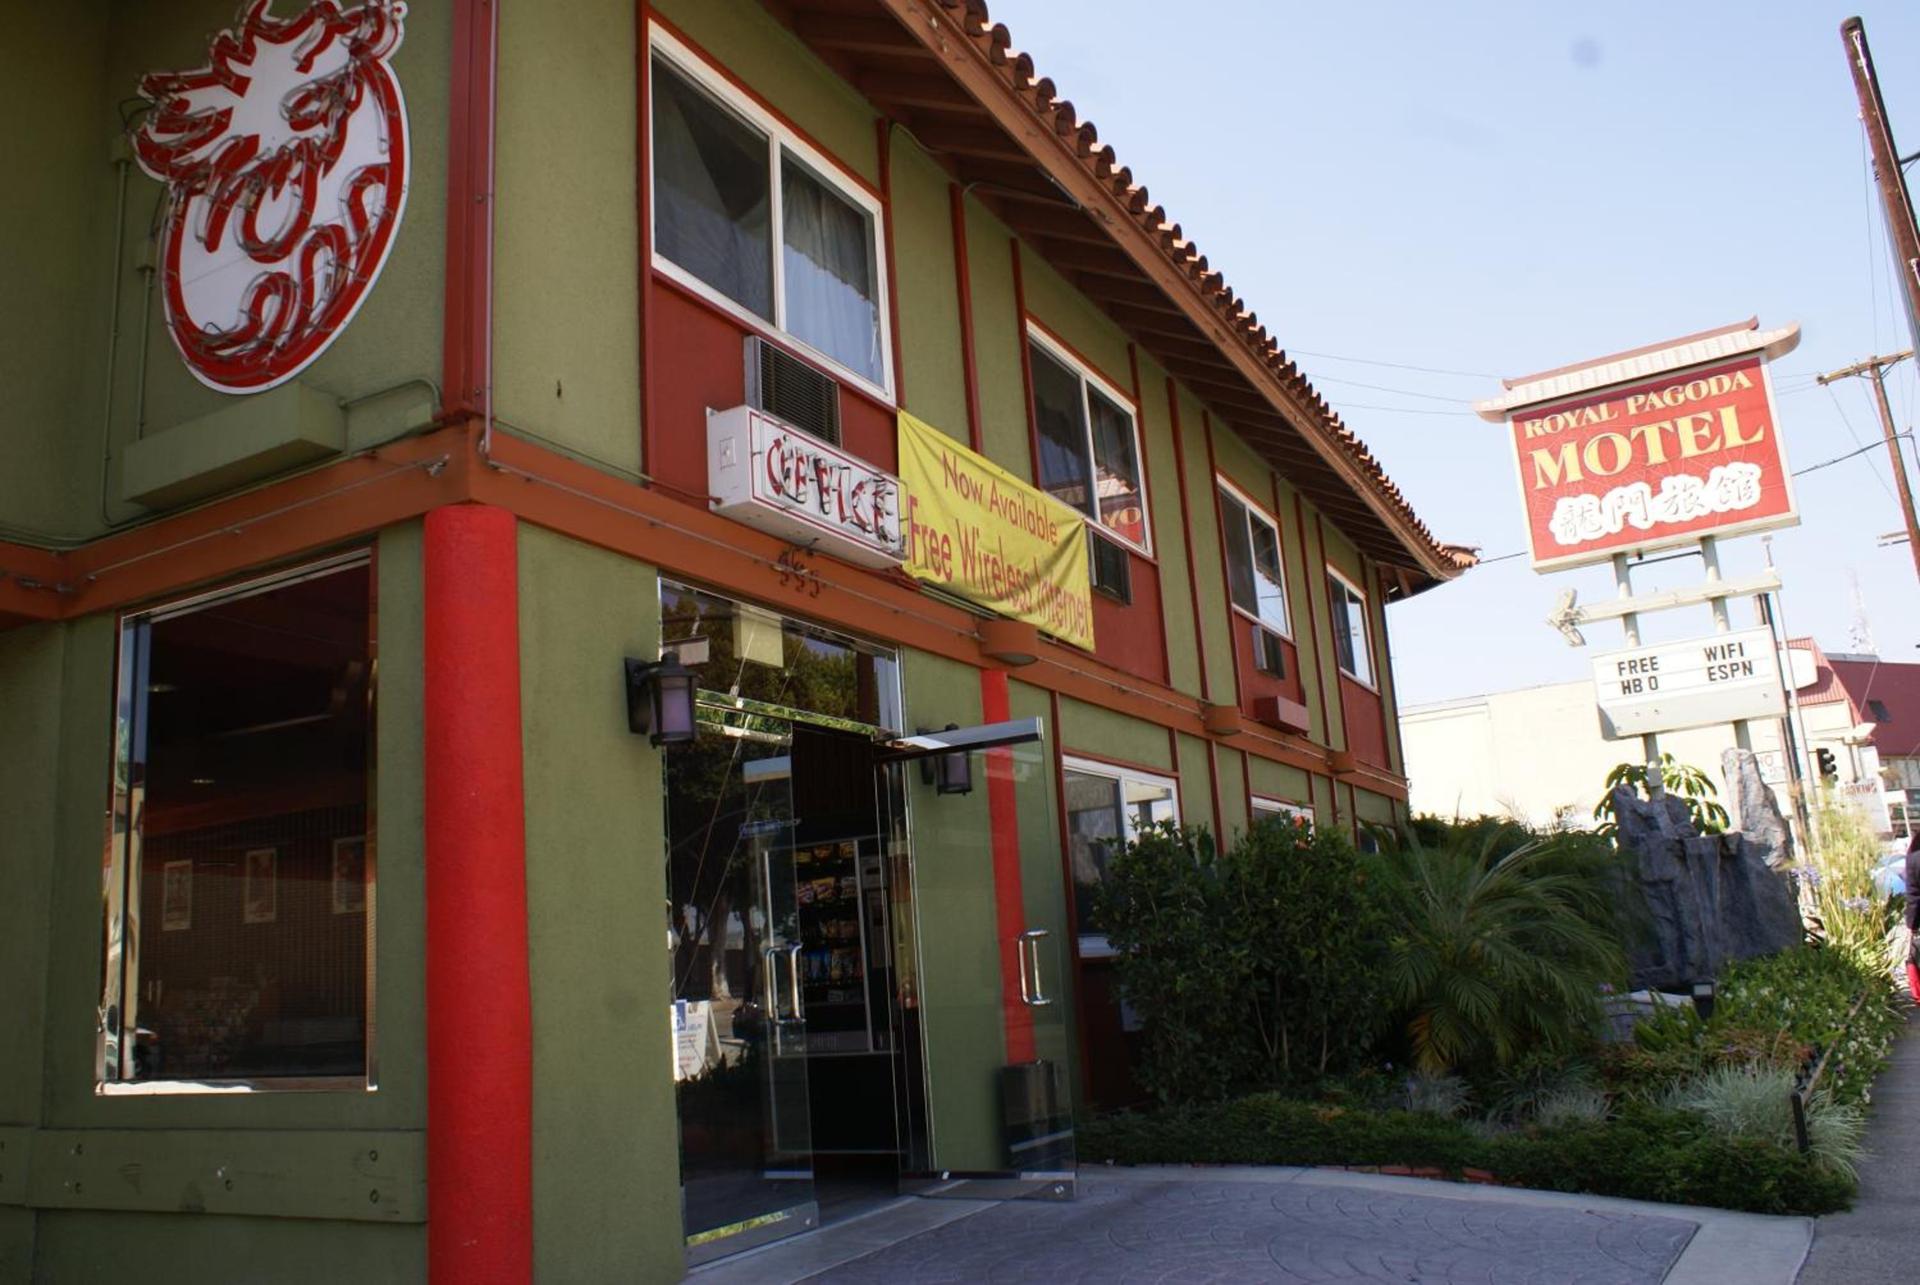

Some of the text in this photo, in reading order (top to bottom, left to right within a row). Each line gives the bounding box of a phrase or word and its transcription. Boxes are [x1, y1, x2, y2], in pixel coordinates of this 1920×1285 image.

[1523, 371, 1753, 439] ROYAL PAGODA
[1529, 405, 1764, 490] MOTEL
[941, 451, 1058, 546] Now Available
[1551, 463, 1762, 544] 龍門旅館
[909, 494, 952, 582] Free
[956, 518, 1032, 613] Wireless
[1617, 642, 1744, 677] FREE WIFI
[1708, 661, 1753, 682] ESPN
